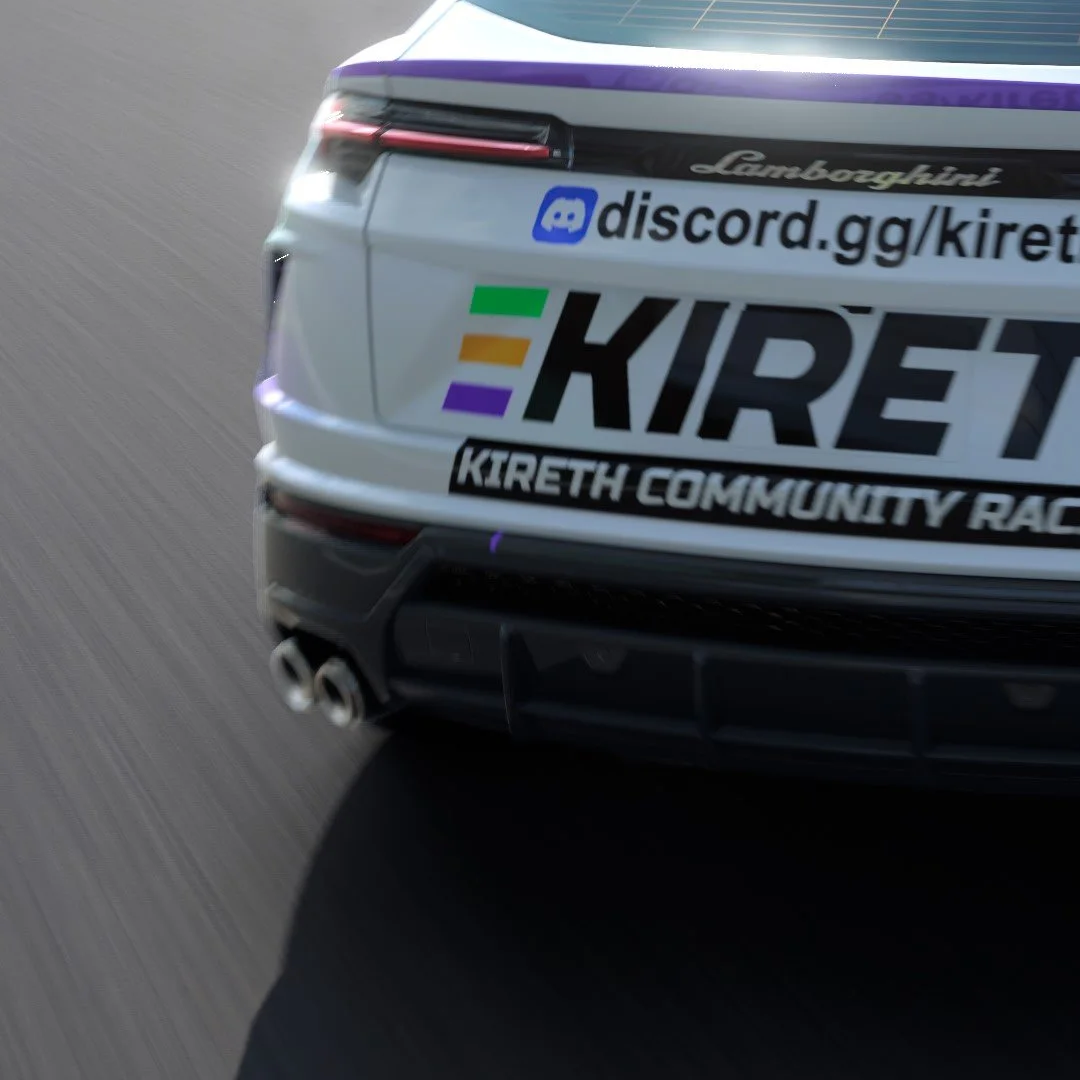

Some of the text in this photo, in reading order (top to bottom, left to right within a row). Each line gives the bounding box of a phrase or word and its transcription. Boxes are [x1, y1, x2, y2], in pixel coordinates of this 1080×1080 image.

[690, 150, 1003, 190] Lamborghini
[457, 447, 629, 501] KIRETH
[637, 468, 966, 528] COMMUNITY
